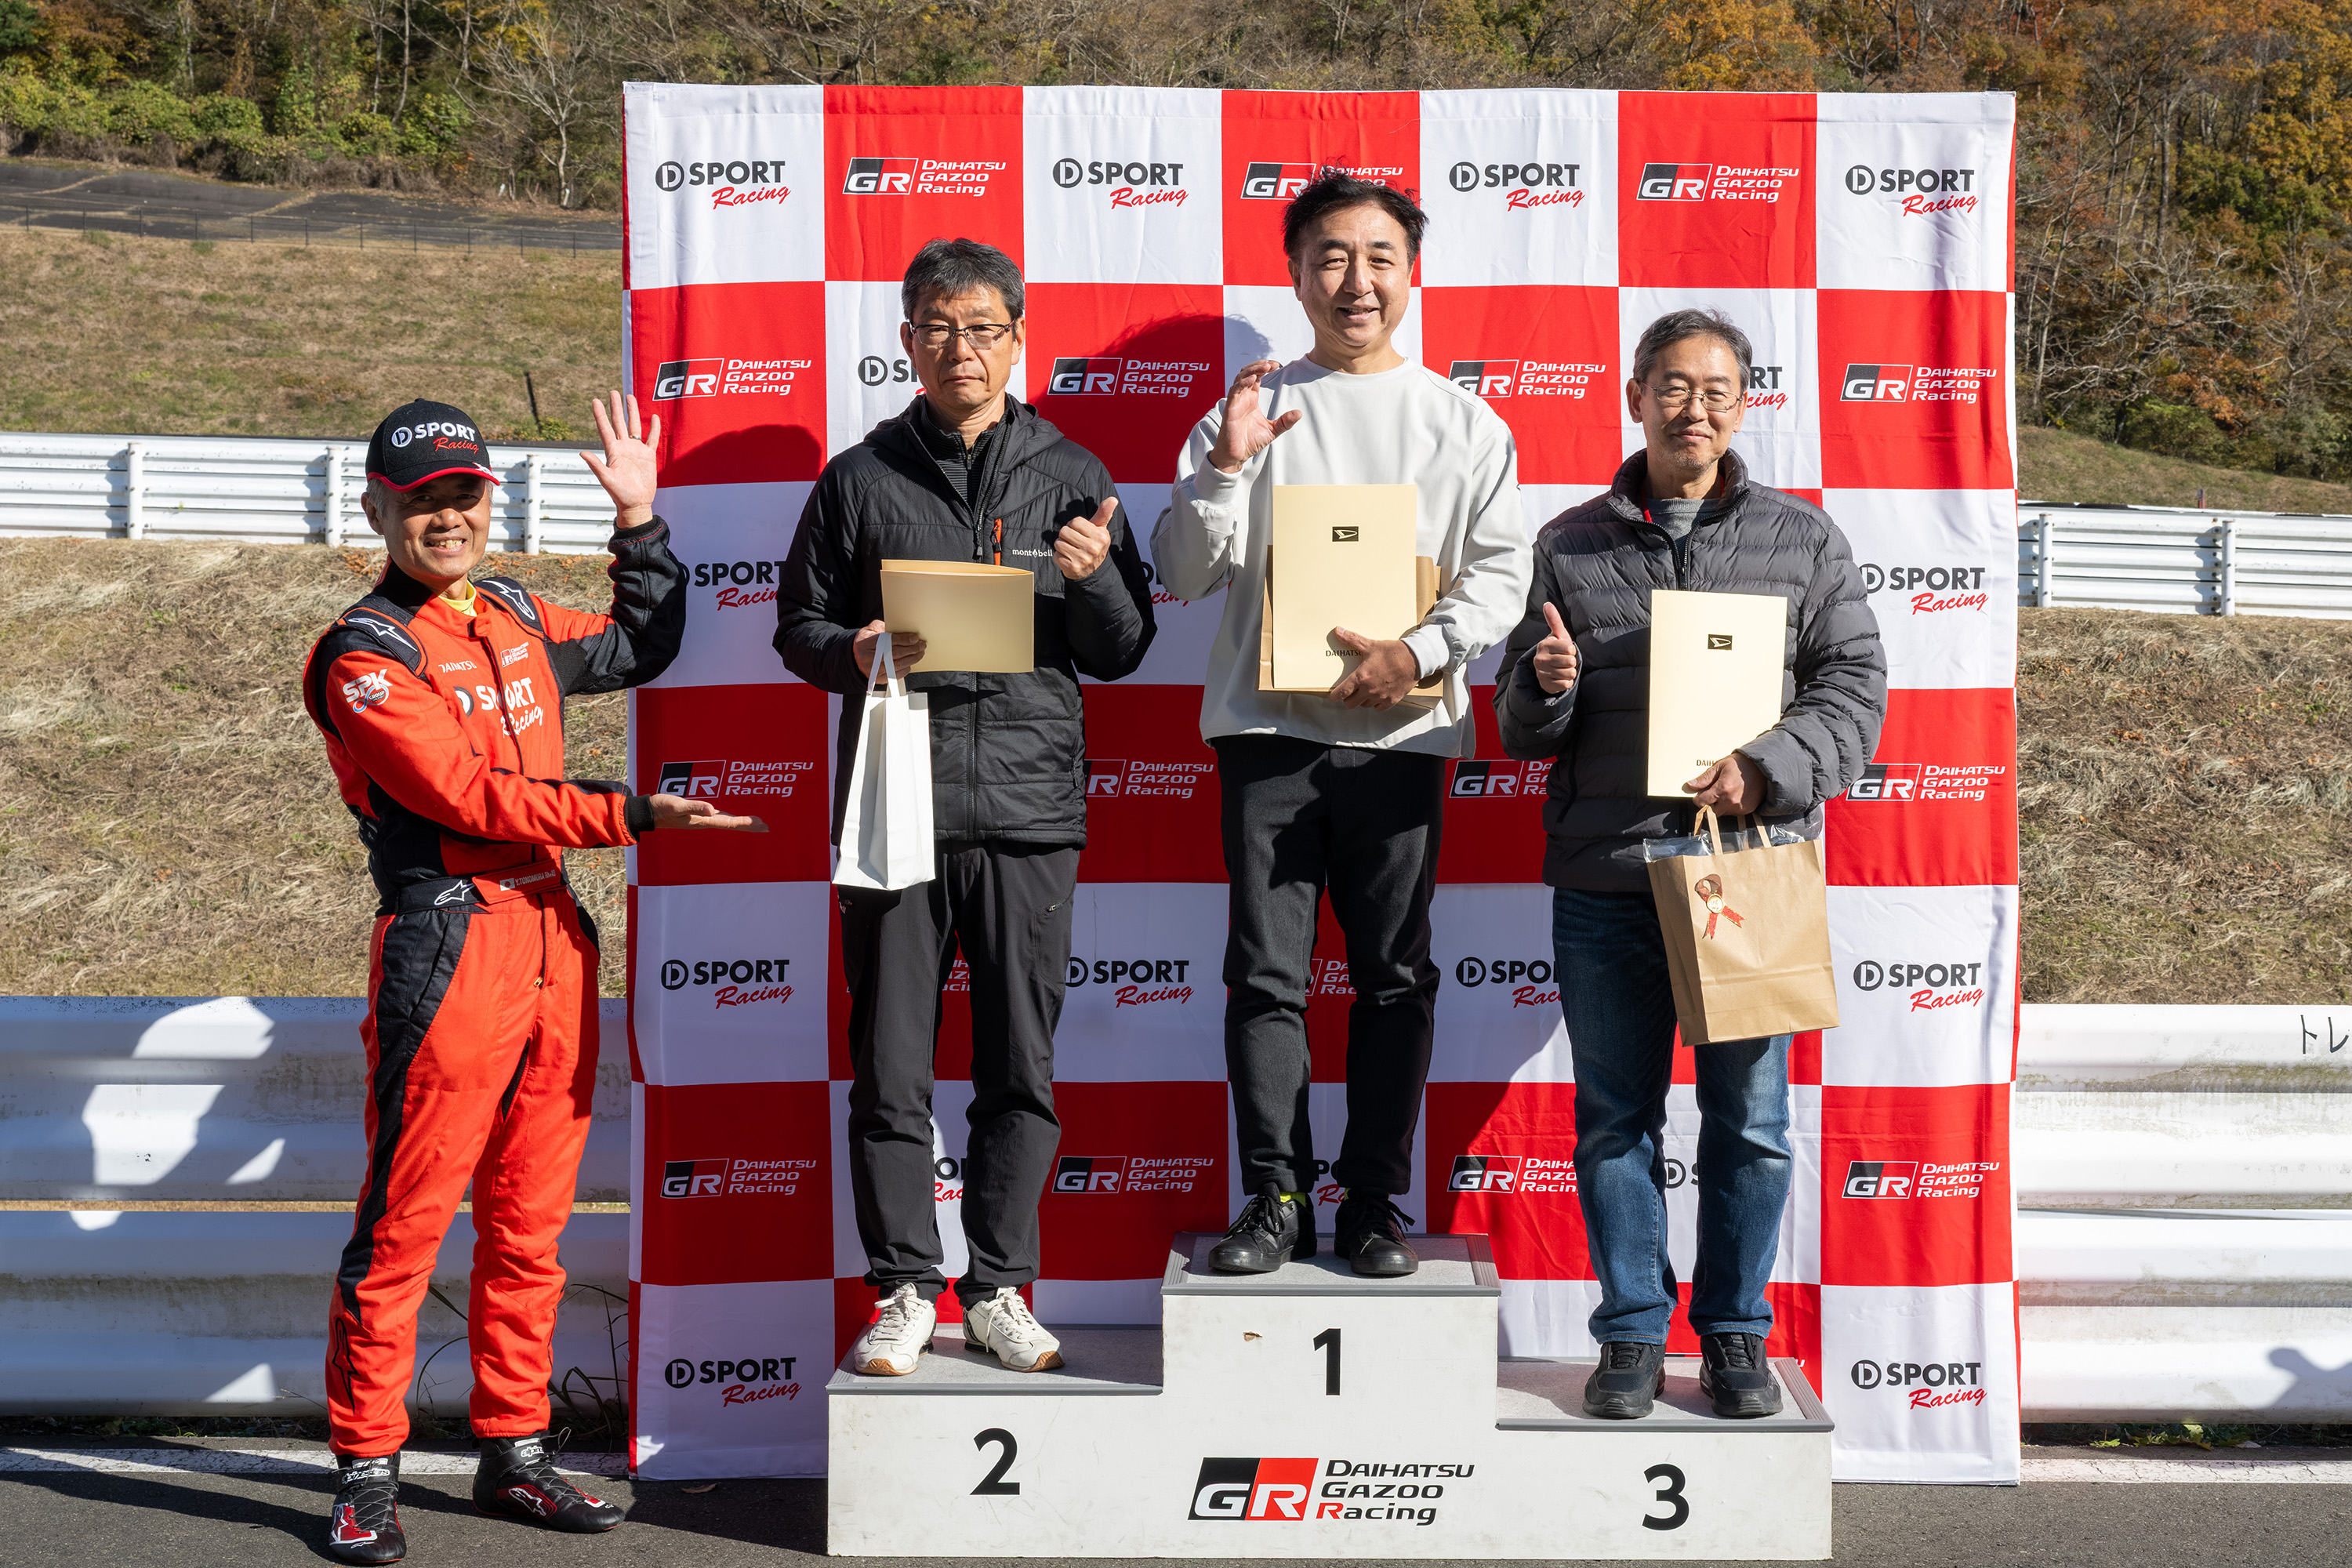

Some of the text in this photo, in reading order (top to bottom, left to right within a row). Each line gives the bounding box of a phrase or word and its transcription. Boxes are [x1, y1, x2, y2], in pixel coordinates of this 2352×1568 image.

[922, 160, 1006, 169] DAIHATSU
[1057, 160, 1183, 187] D SPORT
[1716, 166, 1799, 176] DAIHATSU
[659, 161, 785, 190] D SPORT
[848, 173, 910, 191] GR
[920, 172, 989, 181] GAZOO
[1454, 163, 1580, 191] D SPORT
[1714, 178, 1782, 187] GAZOO
[1849, 166, 1974, 193] D SPORT
[917, 183, 985, 196] Racing
[1247, 178, 1308, 196] GR
[1642, 179, 1704, 198] GR
[1711, 190, 1779, 202] Racing
[712, 187, 790, 209] Racing
[1110, 187, 1189, 209] Racing
[1507, 189, 1584, 211] Racing
[1902, 195, 1977, 216] Racing
[728, 360, 811, 369] DAIHATSU
[1127, 360, 1210, 371] DAIHATSU
[1523, 361, 1606, 372] DAIHATSU
[1917, 367, 1997, 377] DAIHATSU
[658, 374, 716, 397] GR
[726, 372, 794, 381] GAZOO
[1052, 373, 1114, 392] GR
[1124, 372, 1192, 382] GAZOO
[1520, 373, 1588, 383] GAZOO
[1915, 379, 1980, 389] GAZOO
[723, 383, 790, 395] Racing
[1122, 384, 1189, 397] Racing
[1518, 385, 1585, 398] Racing
[1846, 379, 1905, 399] GR
[1912, 390, 1976, 404] Racing
[1747, 393, 1788, 411] cing
[414, 422, 475, 441] SPORT
[433, 437, 479, 455] Racing
[694, 561, 786, 587] SPORT
[1861, 564, 1985, 593] D SPORT
[716, 587, 778, 611] Racin
[1911, 593, 1988, 615] Racing
[343, 668, 393, 703] SPK
[368, 690, 385, 700] GROUP
[730, 762, 813, 771] DAIHATSU
[1131, 761, 1214, 771] DAIHATSU
[1926, 766, 2005, 775] DAIHATSU
[661, 776, 719, 796] GR
[728, 774, 796, 783] GAZOO
[1087, 775, 1119, 794] R
[1128, 774, 1196, 783] GAZOO
[1454, 775, 1516, 794] GR
[1923, 778, 1988, 787] GAZOO
[725, 785, 793, 797] Racing
[1126, 786, 1192, 798] Racing
[1851, 779, 1914, 798] GR
[1920, 789, 1985, 800] Racing
[665, 960, 789, 989] D SPORT
[1068, 959, 1189, 985] D SPORT
[1460, 959, 1558, 985] D SPO
[1857, 962, 1981, 989] D SPORT
[715, 985, 793, 1008] Racing
[1115, 985, 1192, 1007] Racing
[1320, 985, 1356, 994] Rac
[1512, 985, 1561, 1008] Rac
[1911, 989, 1984, 1011] Racing
[2300, 1014, 2349, 1054] トレ
[734, 1160, 816, 1170] DAIHATSU
[1131, 1158, 1213, 1167] DAIHATSU
[1526, 1159, 1573, 1168] DAIHA
[1922, 1162, 1999, 1174] DAIHATSU
[731, 1172, 799, 1181] GAZOO
[1058, 1172, 1119, 1190] GR
[1129, 1170, 1196, 1179] GAZOO
[1452, 1171, 1514, 1190] GR
[1523, 1171, 1577, 1180] GAZO
[1919, 1174, 1983, 1185] GAZOO
[664, 1174, 721, 1196] GR
[729, 1183, 796, 1195] Racing
[1126, 1180, 1192, 1192] Racing
[1520, 1182, 1578, 1196] Racin
[1847, 1177, 1910, 1196] GR
[1917, 1185, 1979, 1198] Racing
[1313, 1329, 1341, 1396] 1
[669, 1357, 796, 1387] D SPORT
[1855, 1362, 1981, 1388] D SPORT
[722, 1383, 800, 1406] Racing
[1909, 1388, 1987, 1410] Racing
[970, 1428, 1020, 1495] 2
[1326, 1460, 1475, 1477] DAIHATSU
[1321, 1482, 1443, 1498] GAZOO
[1642, 1464, 1689, 1530] 3
[1197, 1483, 1305, 1517] GR
[1316, 1502, 1436, 1527] Racing
